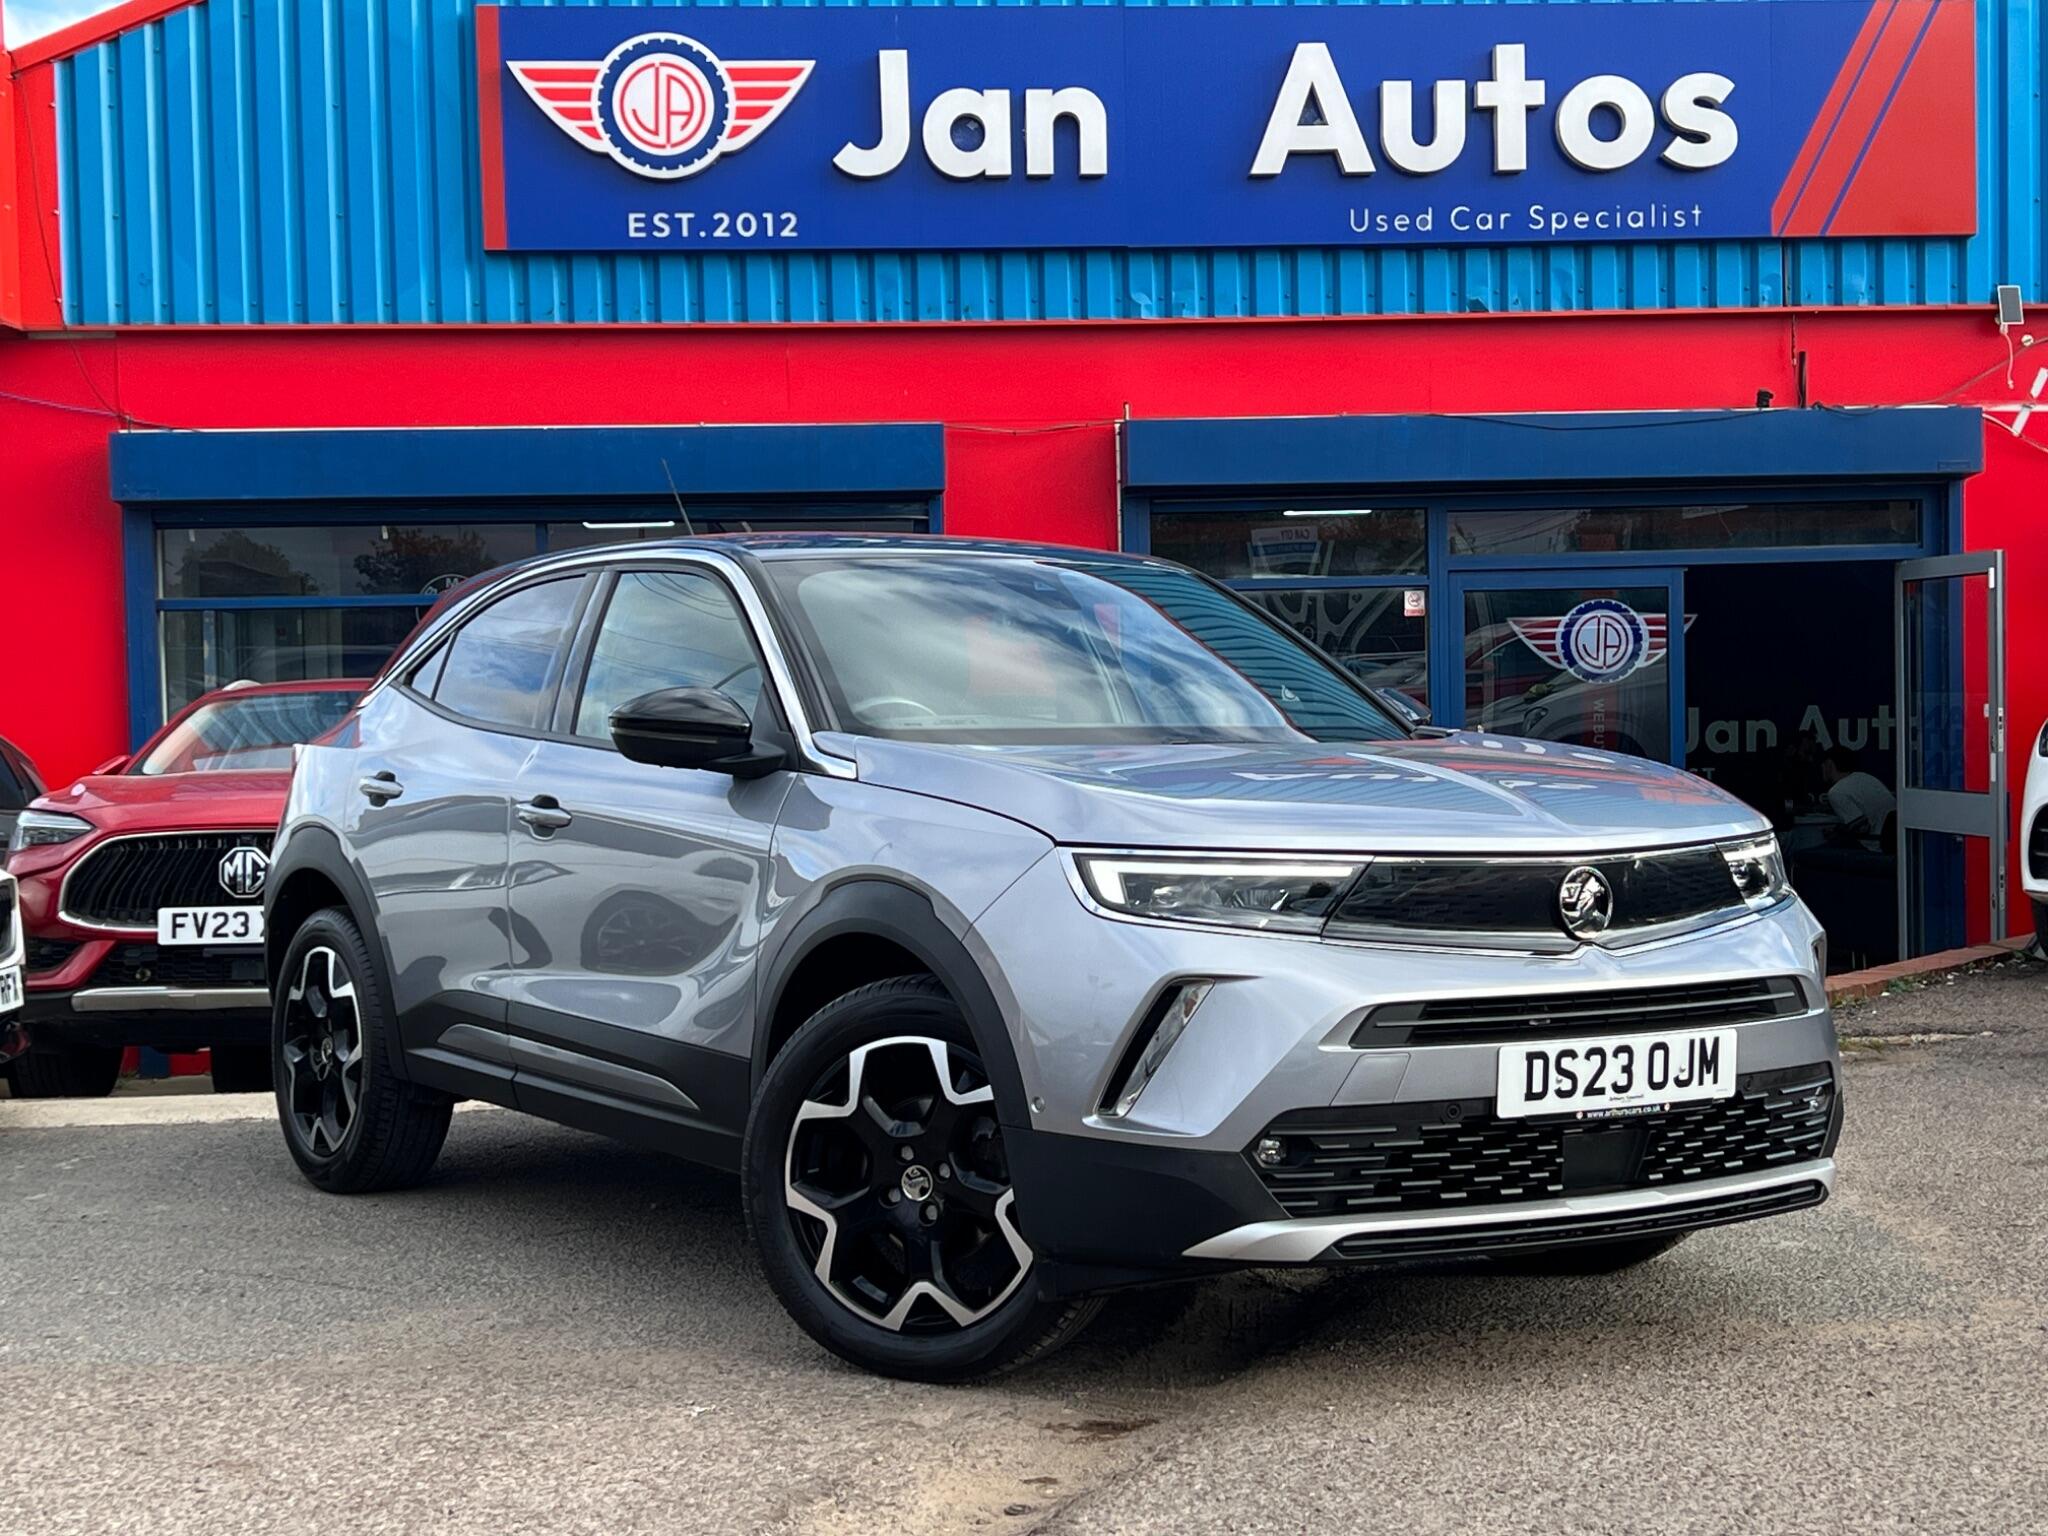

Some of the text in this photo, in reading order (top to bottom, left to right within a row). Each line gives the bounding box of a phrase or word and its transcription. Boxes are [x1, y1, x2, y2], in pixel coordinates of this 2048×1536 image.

[832, 41, 1739, 179] Jan Autos
[628, 212, 799, 239] EST.2012
[1349, 203, 1702, 236] Used Car Specialist
[1685, 706, 1777, 754] Jan
[1799, 704, 1897, 752] Aut
[222, 850, 266, 894] MG
[171, 911, 250, 940] FV23
[1524, 1036, 1720, 1102] DS23 OJM
